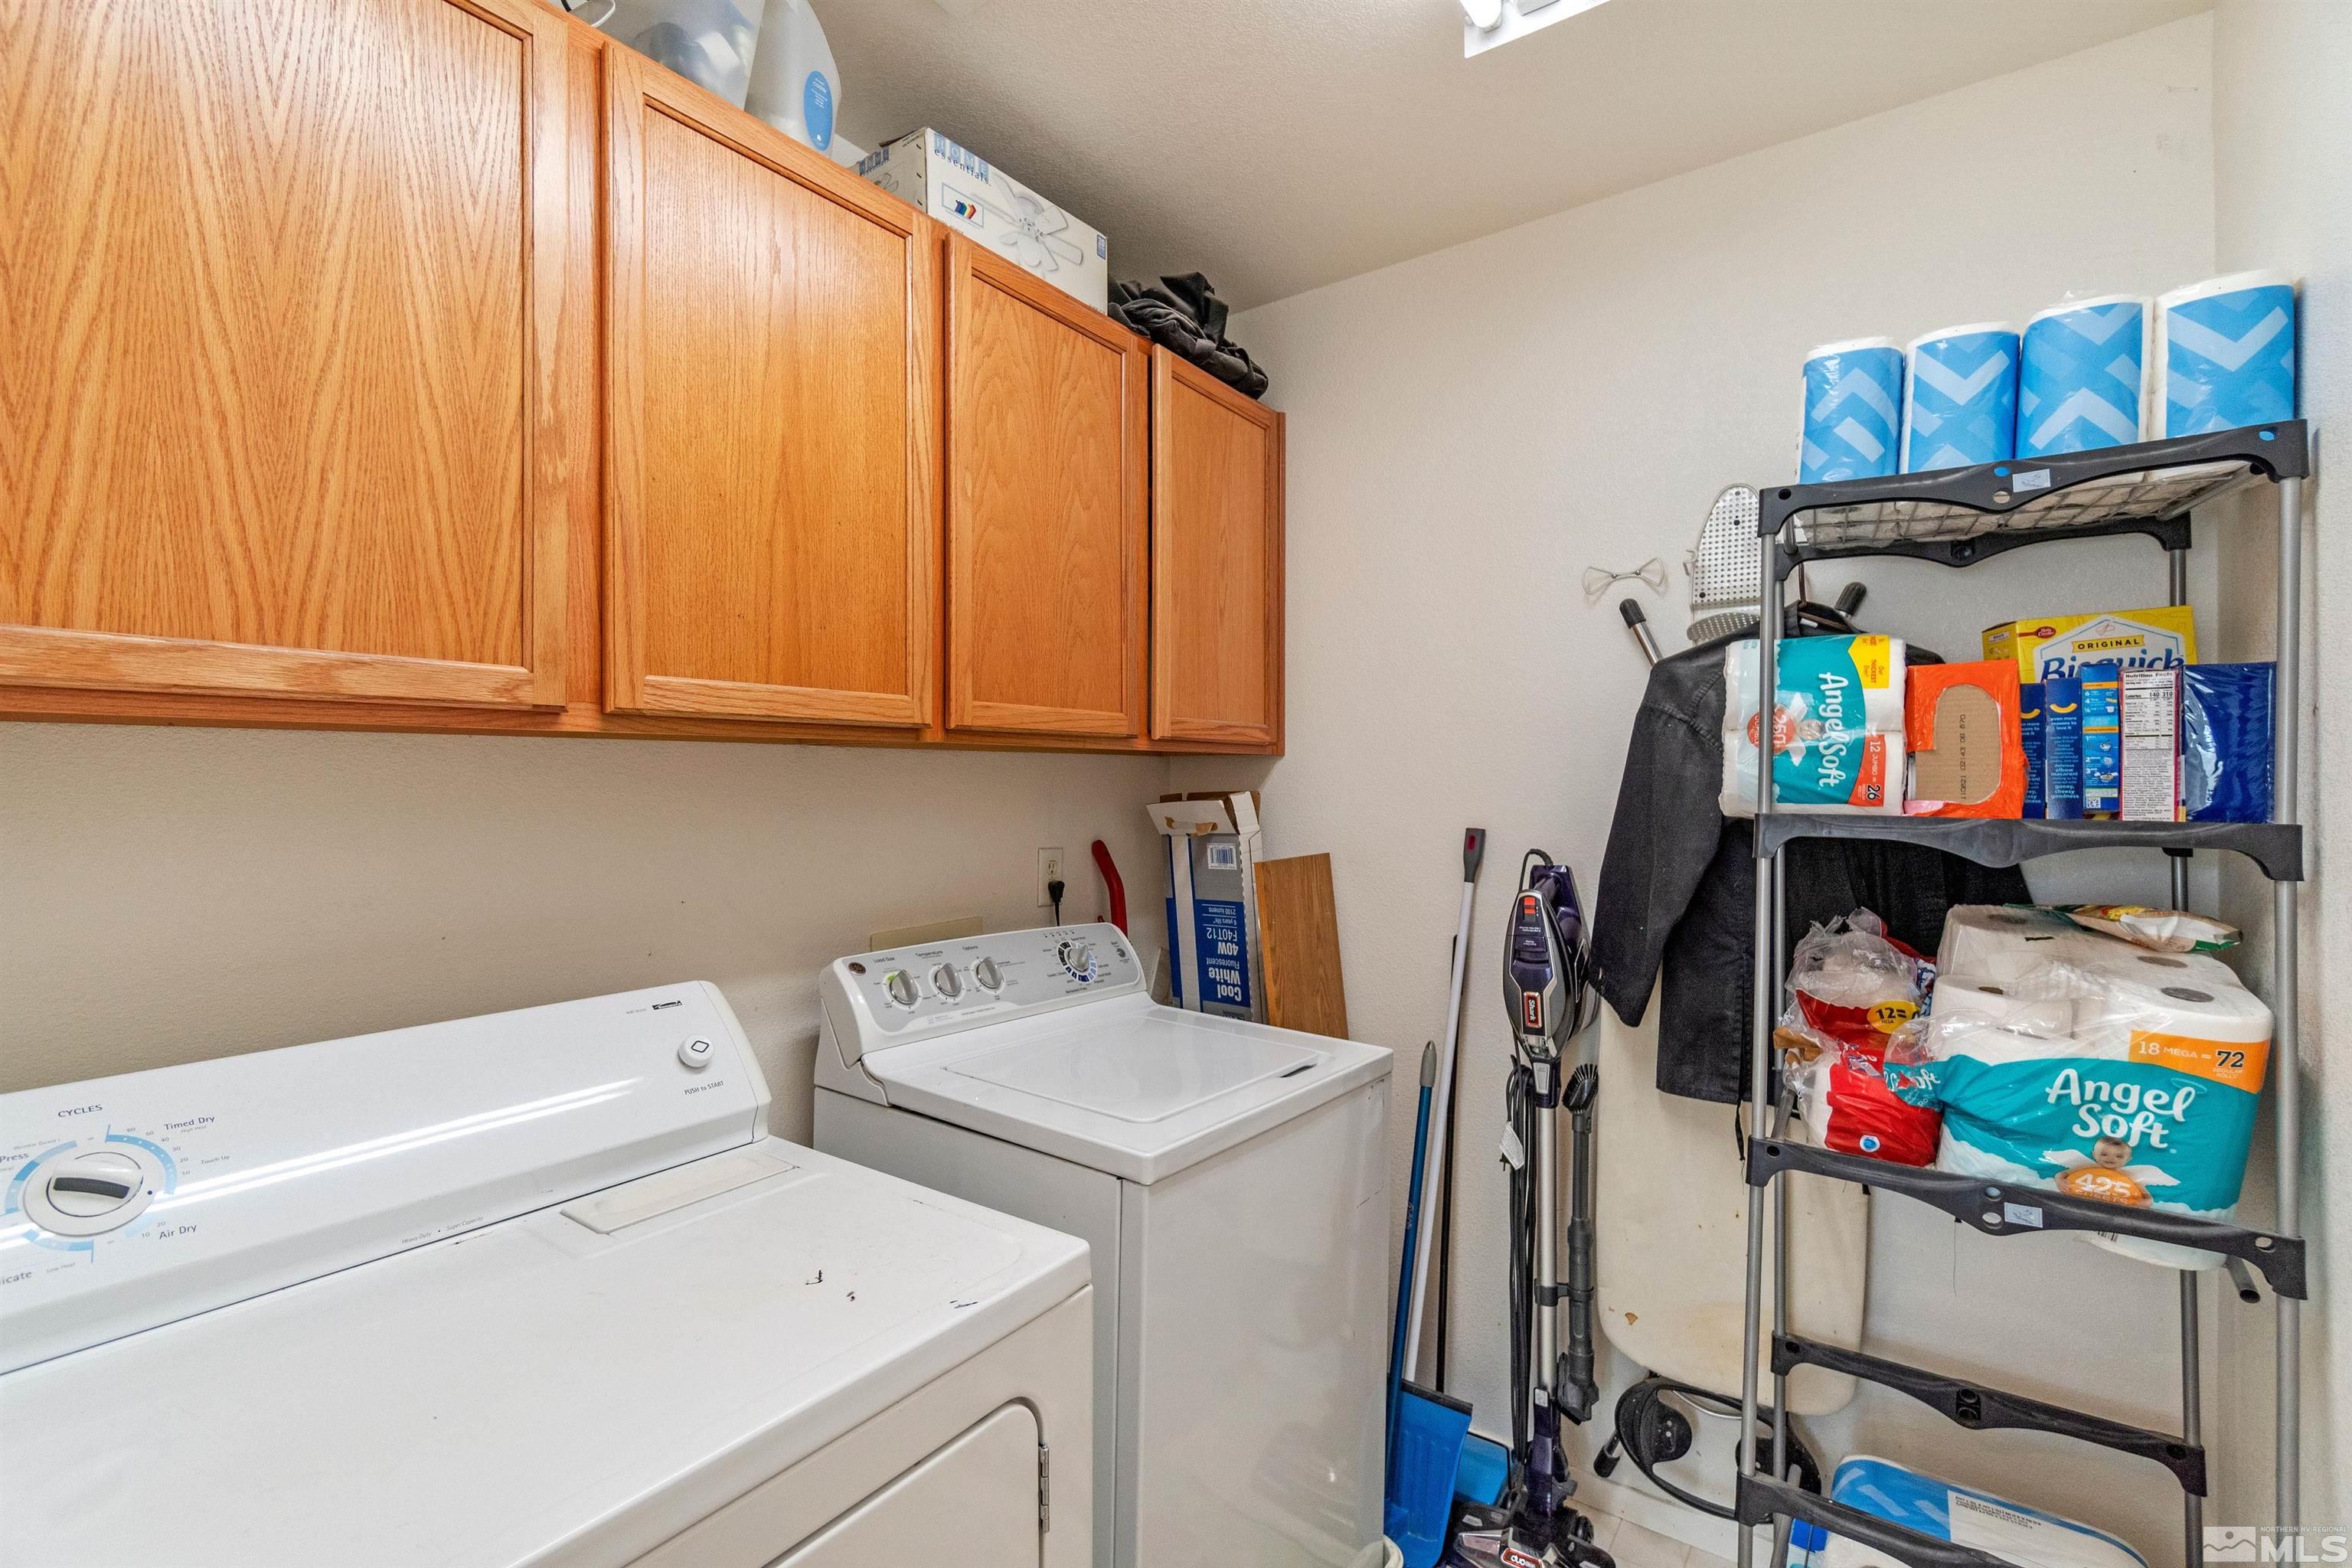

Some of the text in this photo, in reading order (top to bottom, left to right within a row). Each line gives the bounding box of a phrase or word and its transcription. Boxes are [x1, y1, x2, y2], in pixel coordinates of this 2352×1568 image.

[934, 132, 989, 178] HOME
[935, 149, 990, 185] essentials
[2077, 638, 2140, 650] ORIGINAL
[2041, 648, 2185, 679] Biuick
[1818, 671, 1849, 788] Angel Soft
[1870, 740, 1881, 753] 12
[1867, 783, 1881, 801] 26
[1207, 927, 1237, 942] F40T12
[1218, 942, 1239, 956] 40W
[1207, 957, 1240, 969] Fluorescent
[1208, 967, 1240, 985] White
[1217, 984, 1242, 1002] Cool
[2139, 1040, 2161, 1055] 18
[2163, 1047, 2198, 1059] MEGA
[2216, 1049, 2246, 1069] 72
[684, 1086, 700, 1096] PUSH
[707, 1080, 725, 1089] START
[2046, 1068, 2196, 1122] Angel
[58, 1104, 103, 1119] CYCLES
[164, 1116, 215, 1131] Timed Dry
[2073, 1103, 2169, 1150] Soft
[0, 1152, 29, 1163] Press
[2075, 1173, 2132, 1199] 425
[158, 1228, 175, 1240] Air
[178, 1224, 197, 1236] Dry
